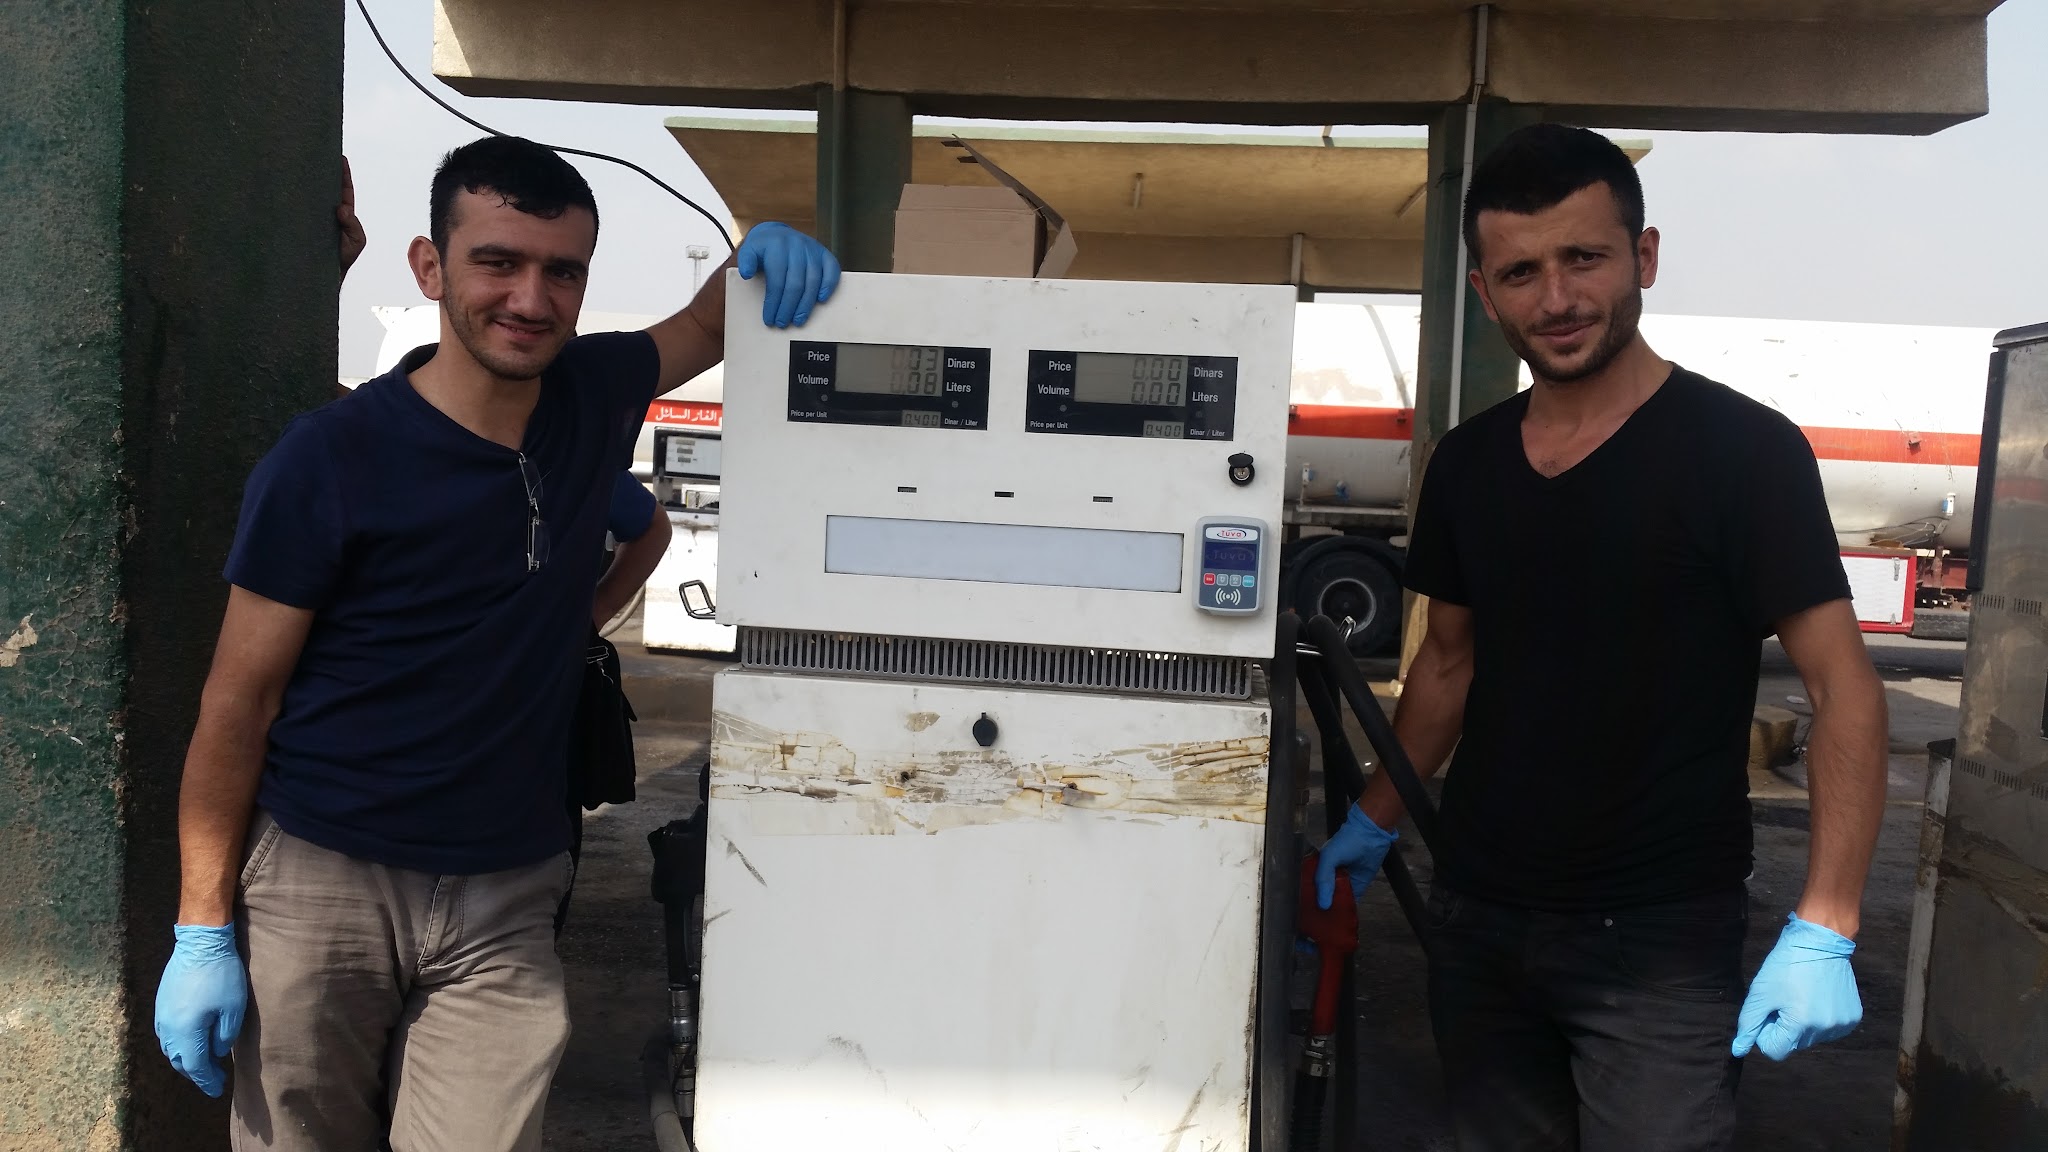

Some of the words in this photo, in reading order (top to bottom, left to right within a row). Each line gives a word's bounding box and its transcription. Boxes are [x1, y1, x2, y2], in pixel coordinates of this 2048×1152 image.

[808, 351, 830, 362] Price
[947, 358, 976, 370] Dinars
[1048, 360, 1072, 372] Price
[1133, 358, 1182, 380] 0.00
[1194, 367, 1224, 379] Dinars
[797, 373, 829, 386] Volume
[946, 382, 972, 393] Liters
[1037, 384, 1070, 396] Volume
[1131, 382, 1180, 405] 0.00
[1192, 391, 1219, 403] Liters
[655, 407, 691, 421] السائل
[790, 409, 804, 418] Price
[805, 411, 815, 419] per
[816, 410, 828, 418] Unit
[1030, 420, 1044, 429] Price
[1056, 421, 1068, 429] Unit
[1190, 428, 1205, 436] Dinar
[1211, 429, 1225, 437] Liter
